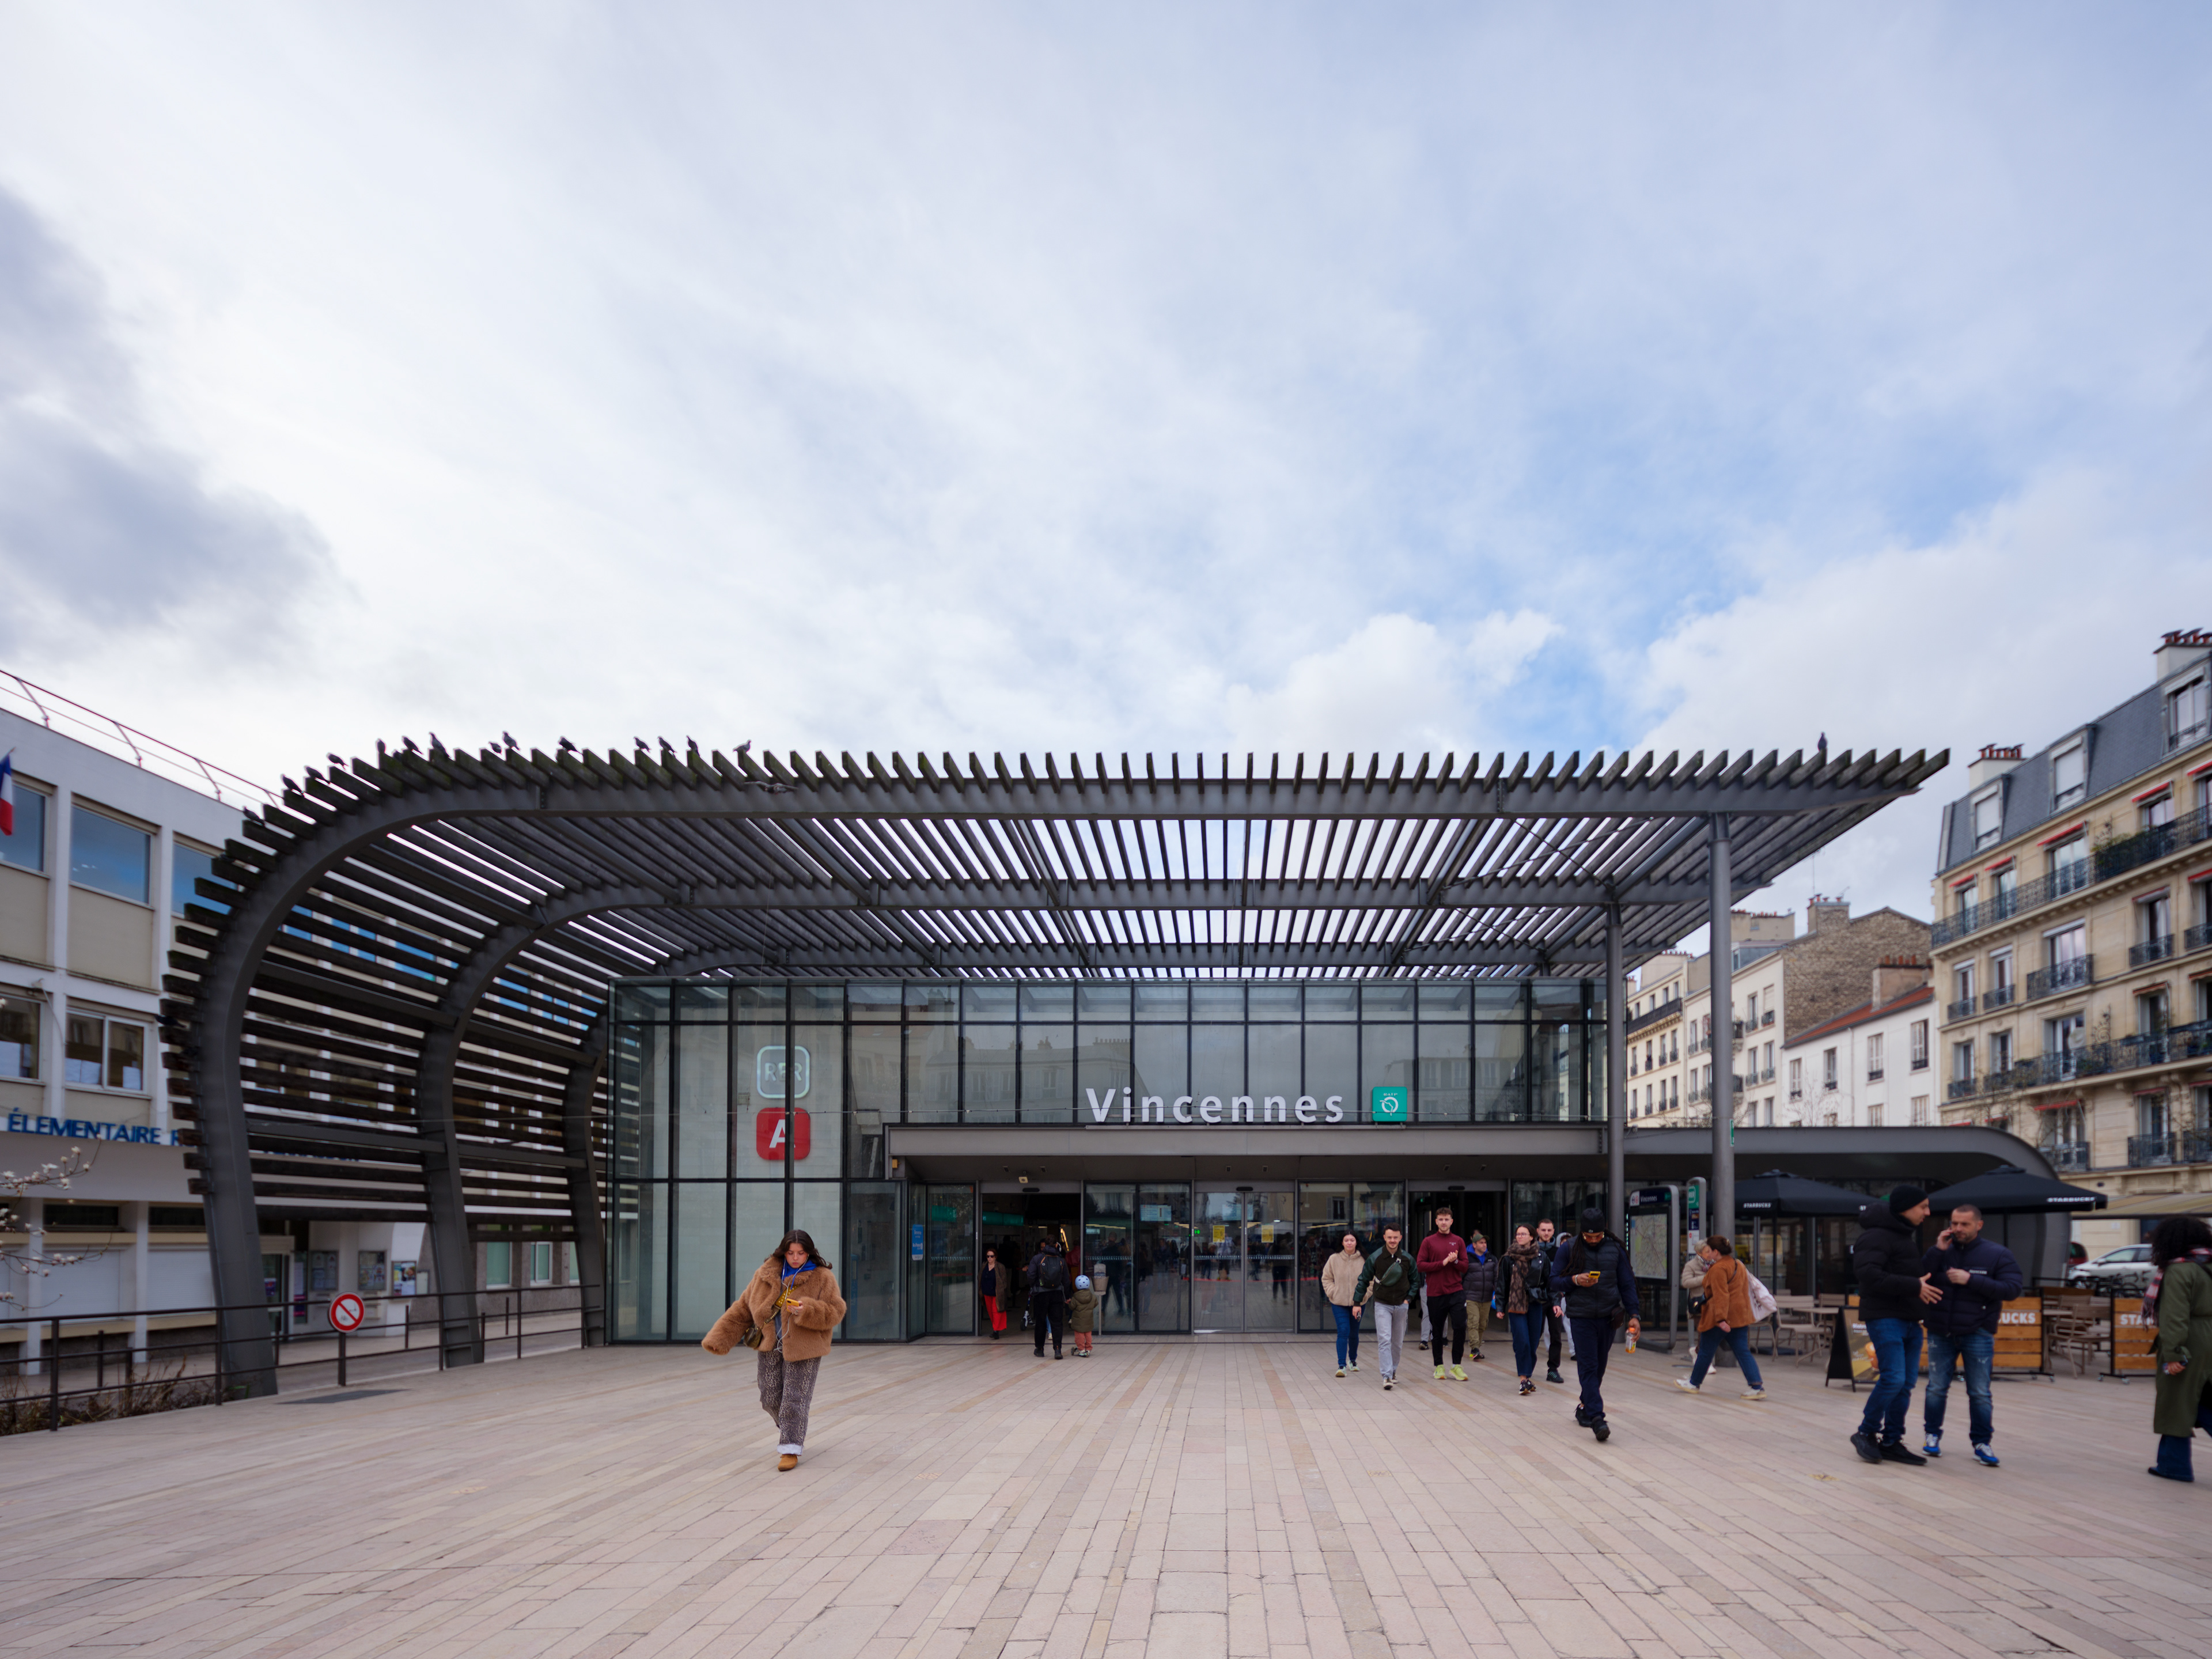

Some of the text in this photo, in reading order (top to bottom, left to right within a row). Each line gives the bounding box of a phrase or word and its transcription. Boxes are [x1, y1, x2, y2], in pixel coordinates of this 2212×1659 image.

[764, 1062, 802, 1081] RER
[1086, 1087, 1343, 1123] Vincennes
[8, 1107, 161, 1145] ÉLEMENTAIRE
[769, 1119, 796, 1148] A
[1998, 1313, 2036, 1324] UCKS
